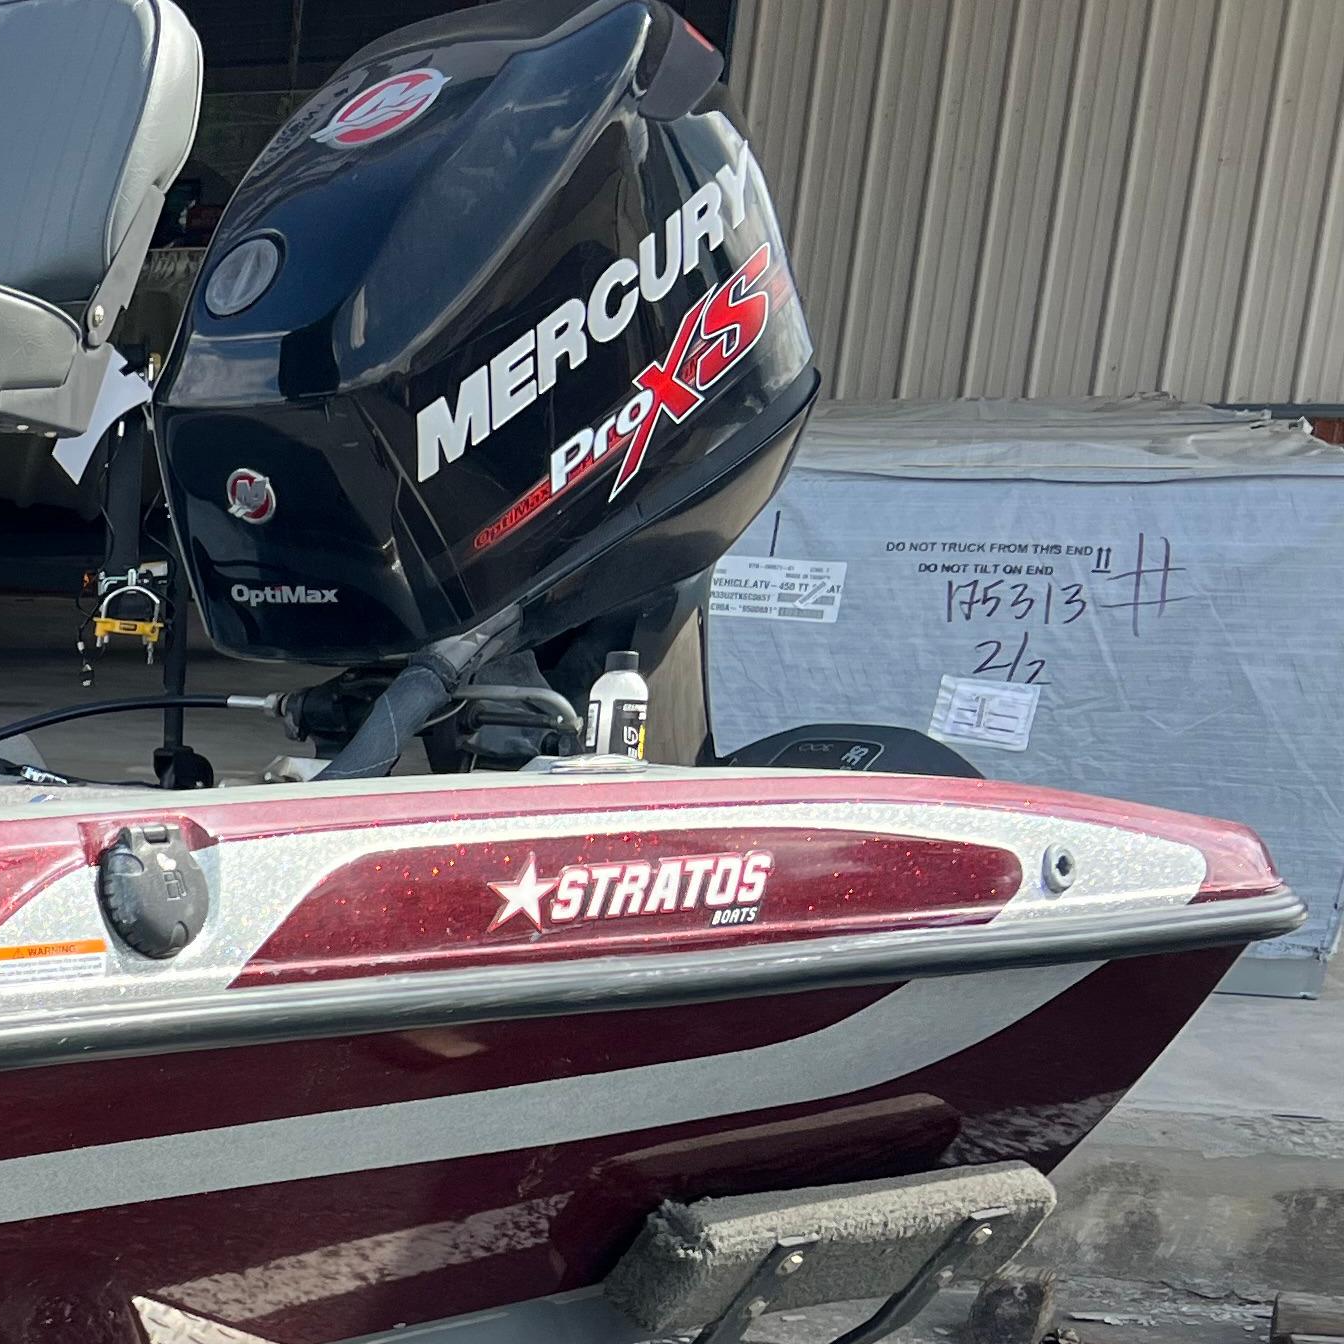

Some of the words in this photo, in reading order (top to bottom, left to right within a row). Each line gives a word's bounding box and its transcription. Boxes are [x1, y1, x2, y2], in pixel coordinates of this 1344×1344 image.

[417, 140, 750, 484] MERCURY
[886, 541, 906, 552] DO
[908, 542, 937, 552] NOT
[941, 542, 985, 553] TRUCK
[990, 543, 1029, 555] FROM
[1032, 543, 1063, 555] THIS
[1065, 545, 1094, 556] END
[918, 562, 939, 574] DO
[941, 563, 968, 574] NOT
[973, 563, 1000, 575] TILT
[1002, 564, 1024, 575] ON
[1026, 564, 1054, 576] END
[231, 583, 339, 607] OptiMax
[946, 579, 1087, 624] 175313
[972, 631, 1052, 684] 2/2
[550, 850, 775, 924] STRATOS
[711, 906, 758, 926] BOATS
[28, 944, 76, 957] WARNING
